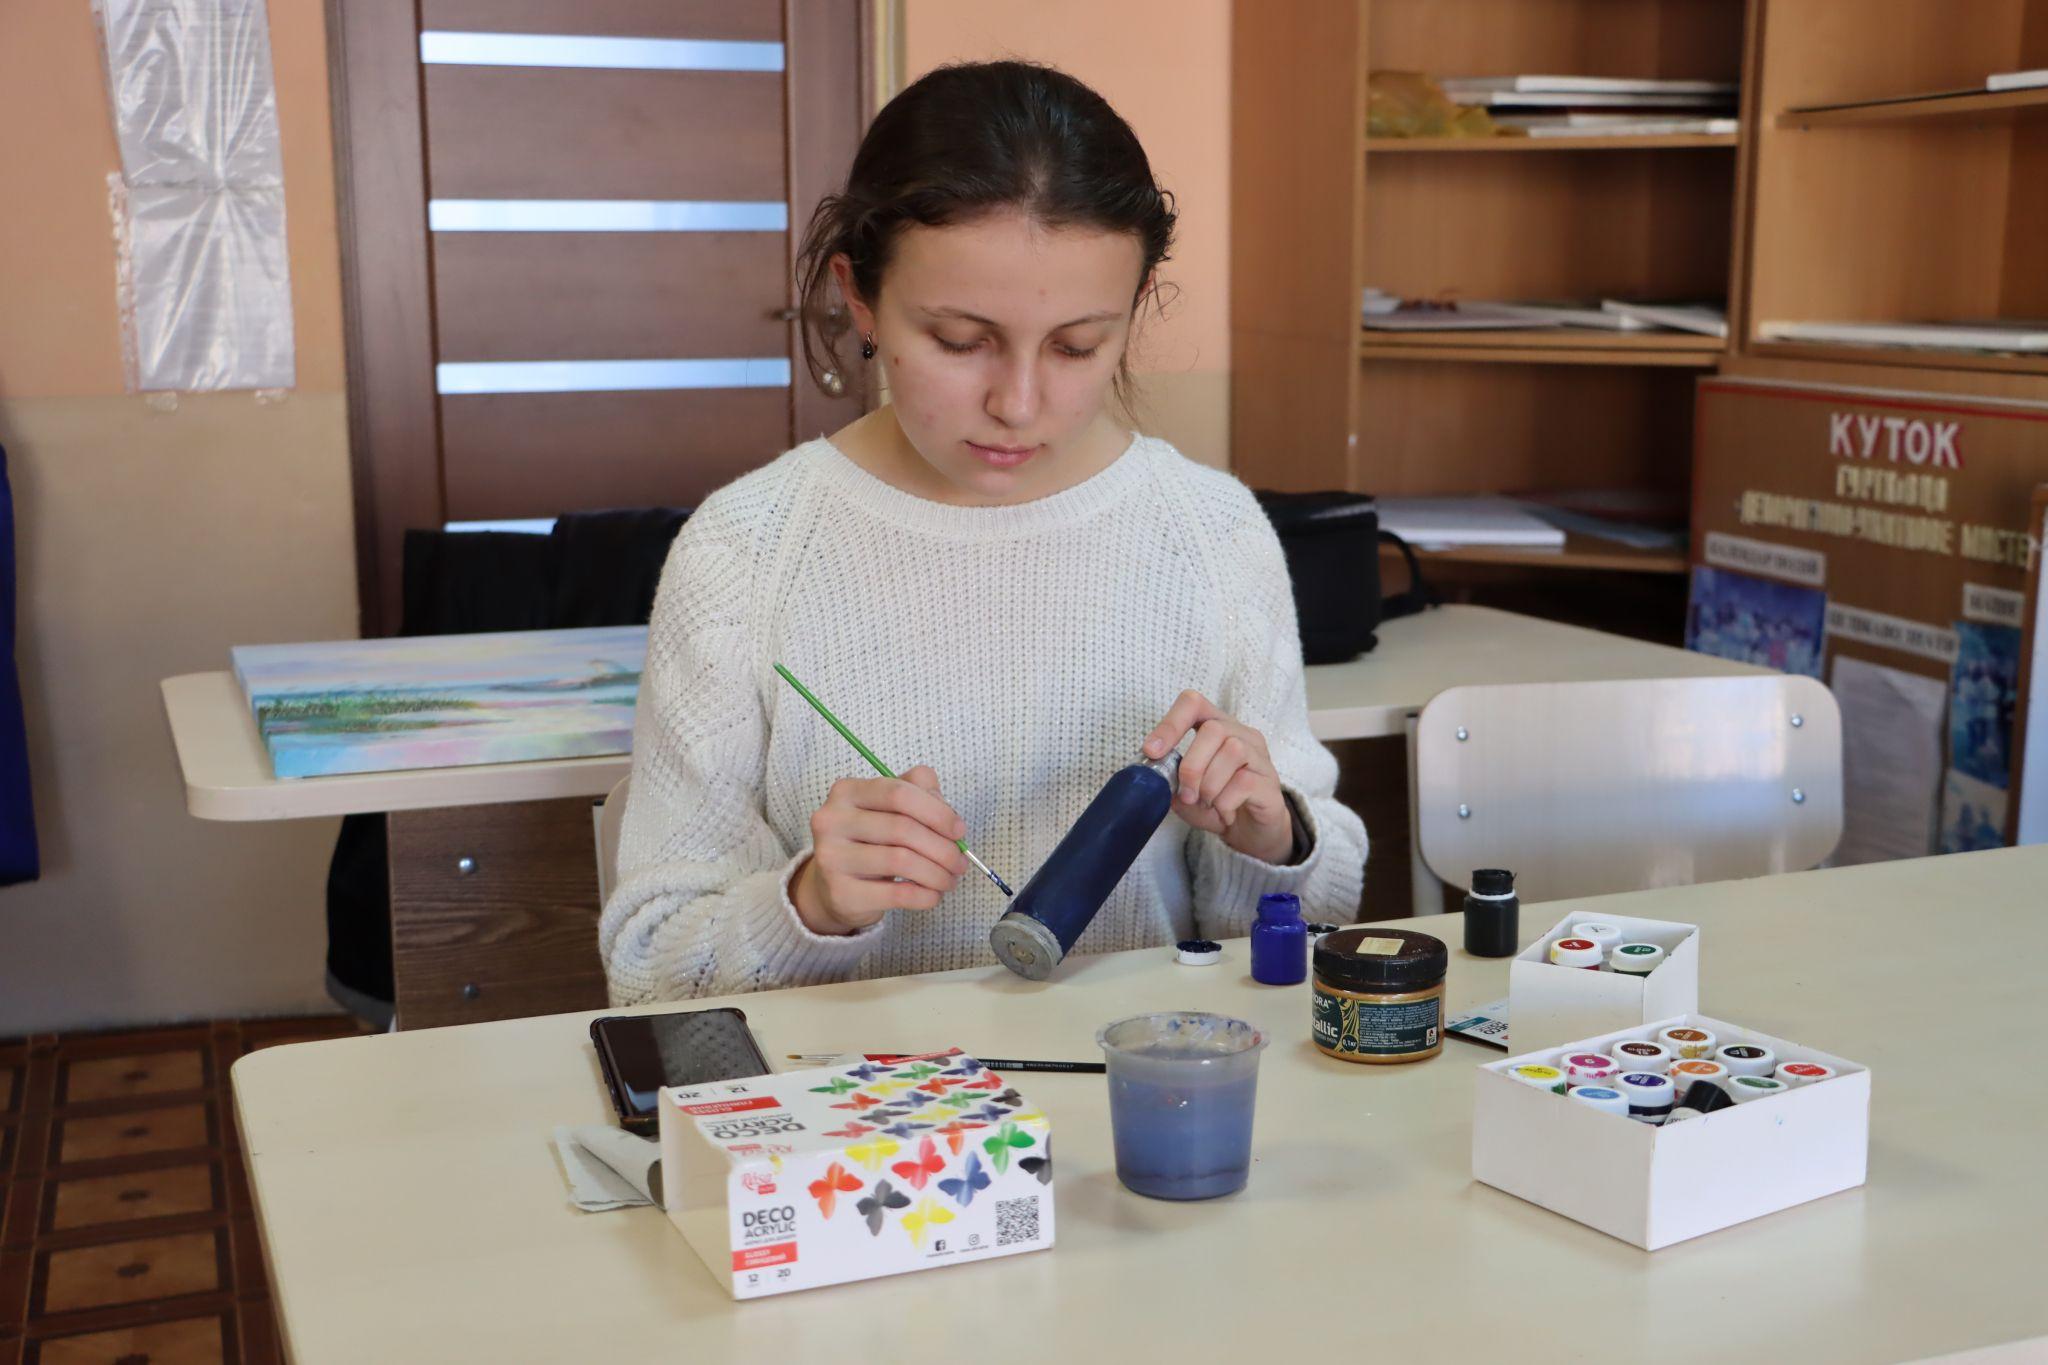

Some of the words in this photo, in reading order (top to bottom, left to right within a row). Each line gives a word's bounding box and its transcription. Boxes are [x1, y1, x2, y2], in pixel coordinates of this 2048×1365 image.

[1830, 412, 1962, 468] КУТОК
[705, 1116, 793, 1131] ACRYLIC
[714, 1122, 806, 1139] DECO
[743, 1206, 795, 1227] DECO
[745, 1221, 796, 1238] ACRYLIC
[748, 1274, 759, 1282] 12
[777, 1268, 791, 1278] 20
